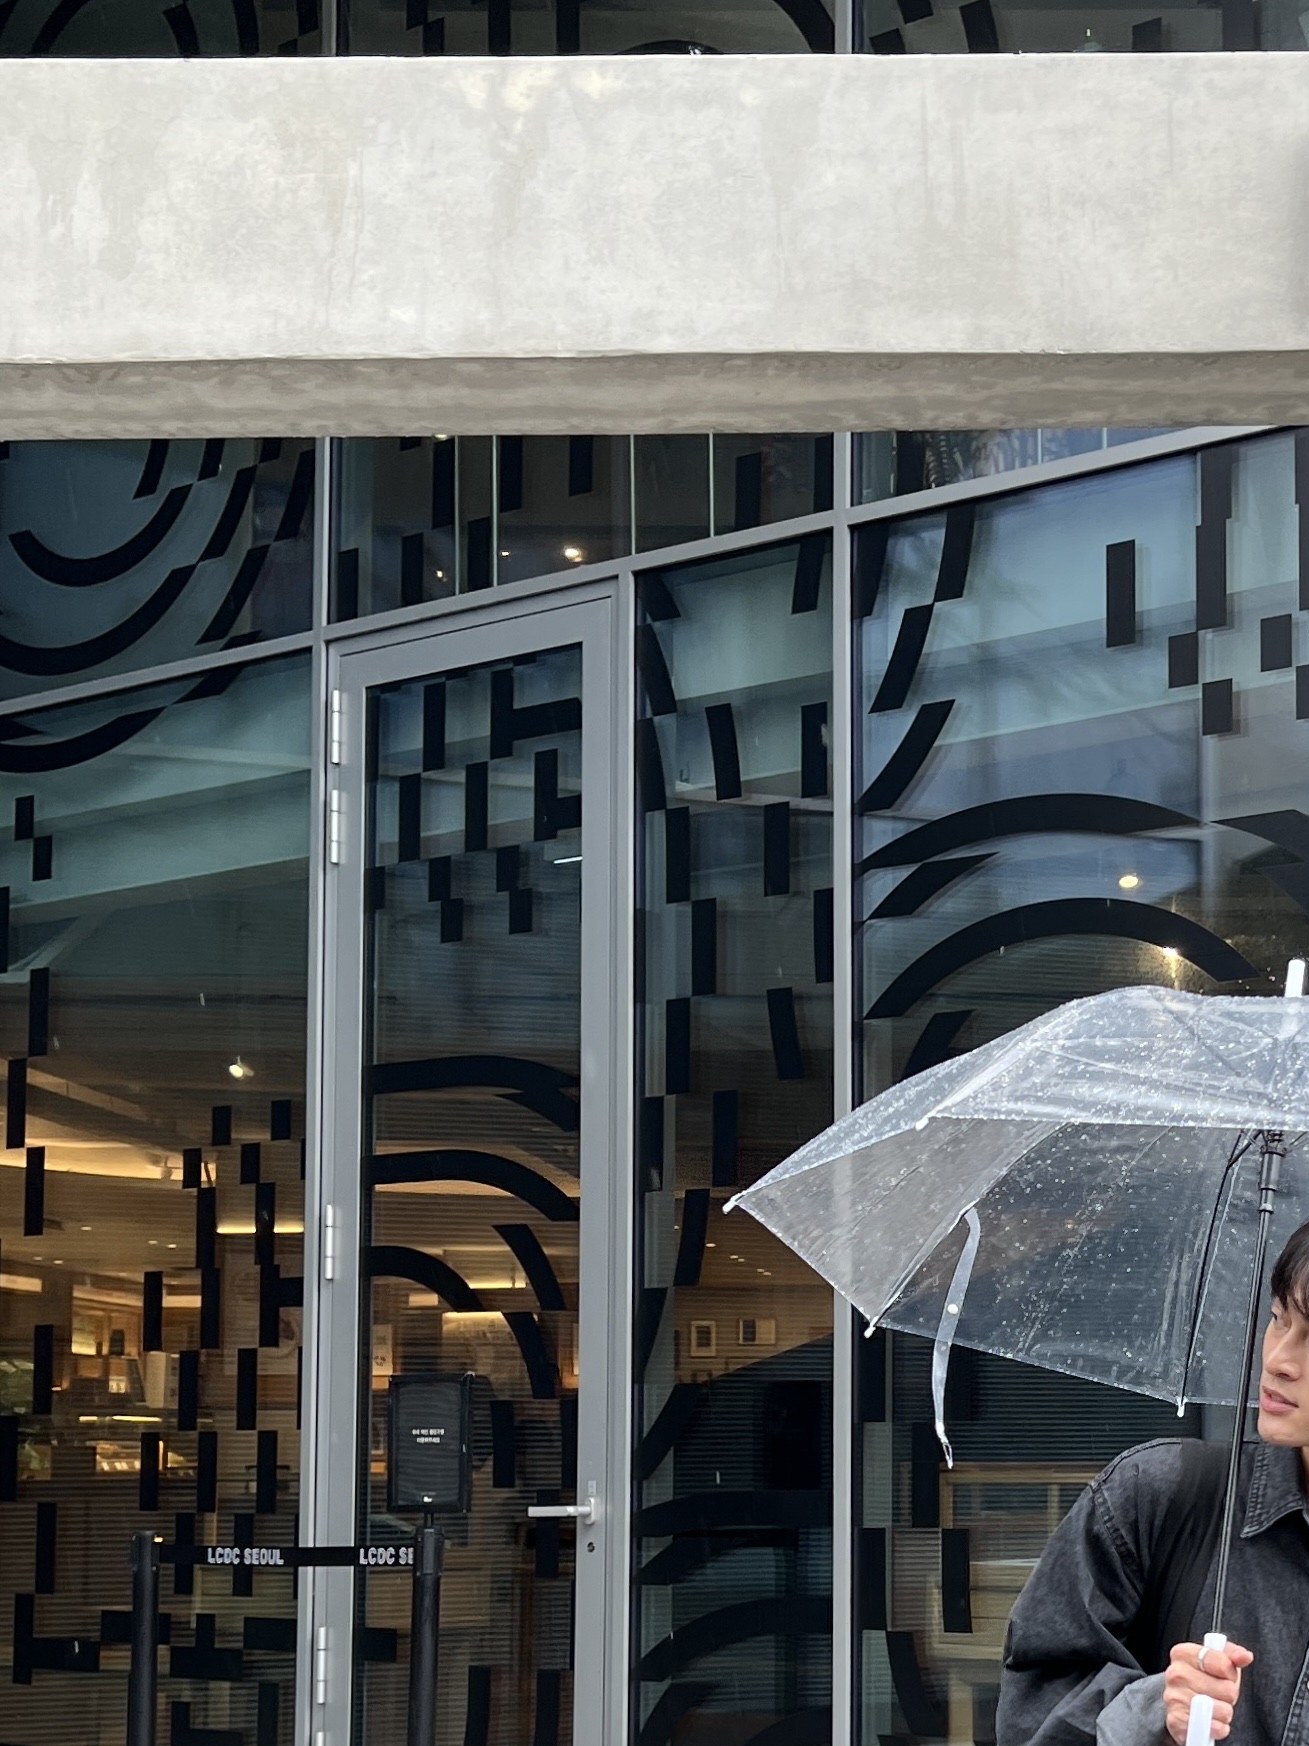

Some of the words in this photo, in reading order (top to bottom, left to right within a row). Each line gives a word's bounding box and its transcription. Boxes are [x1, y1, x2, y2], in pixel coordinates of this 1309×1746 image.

[207, 1547, 240, 1564] LCDC
[243, 1547, 284, 1565] SEOUL
[359, 1548, 395, 1565] LCDC
